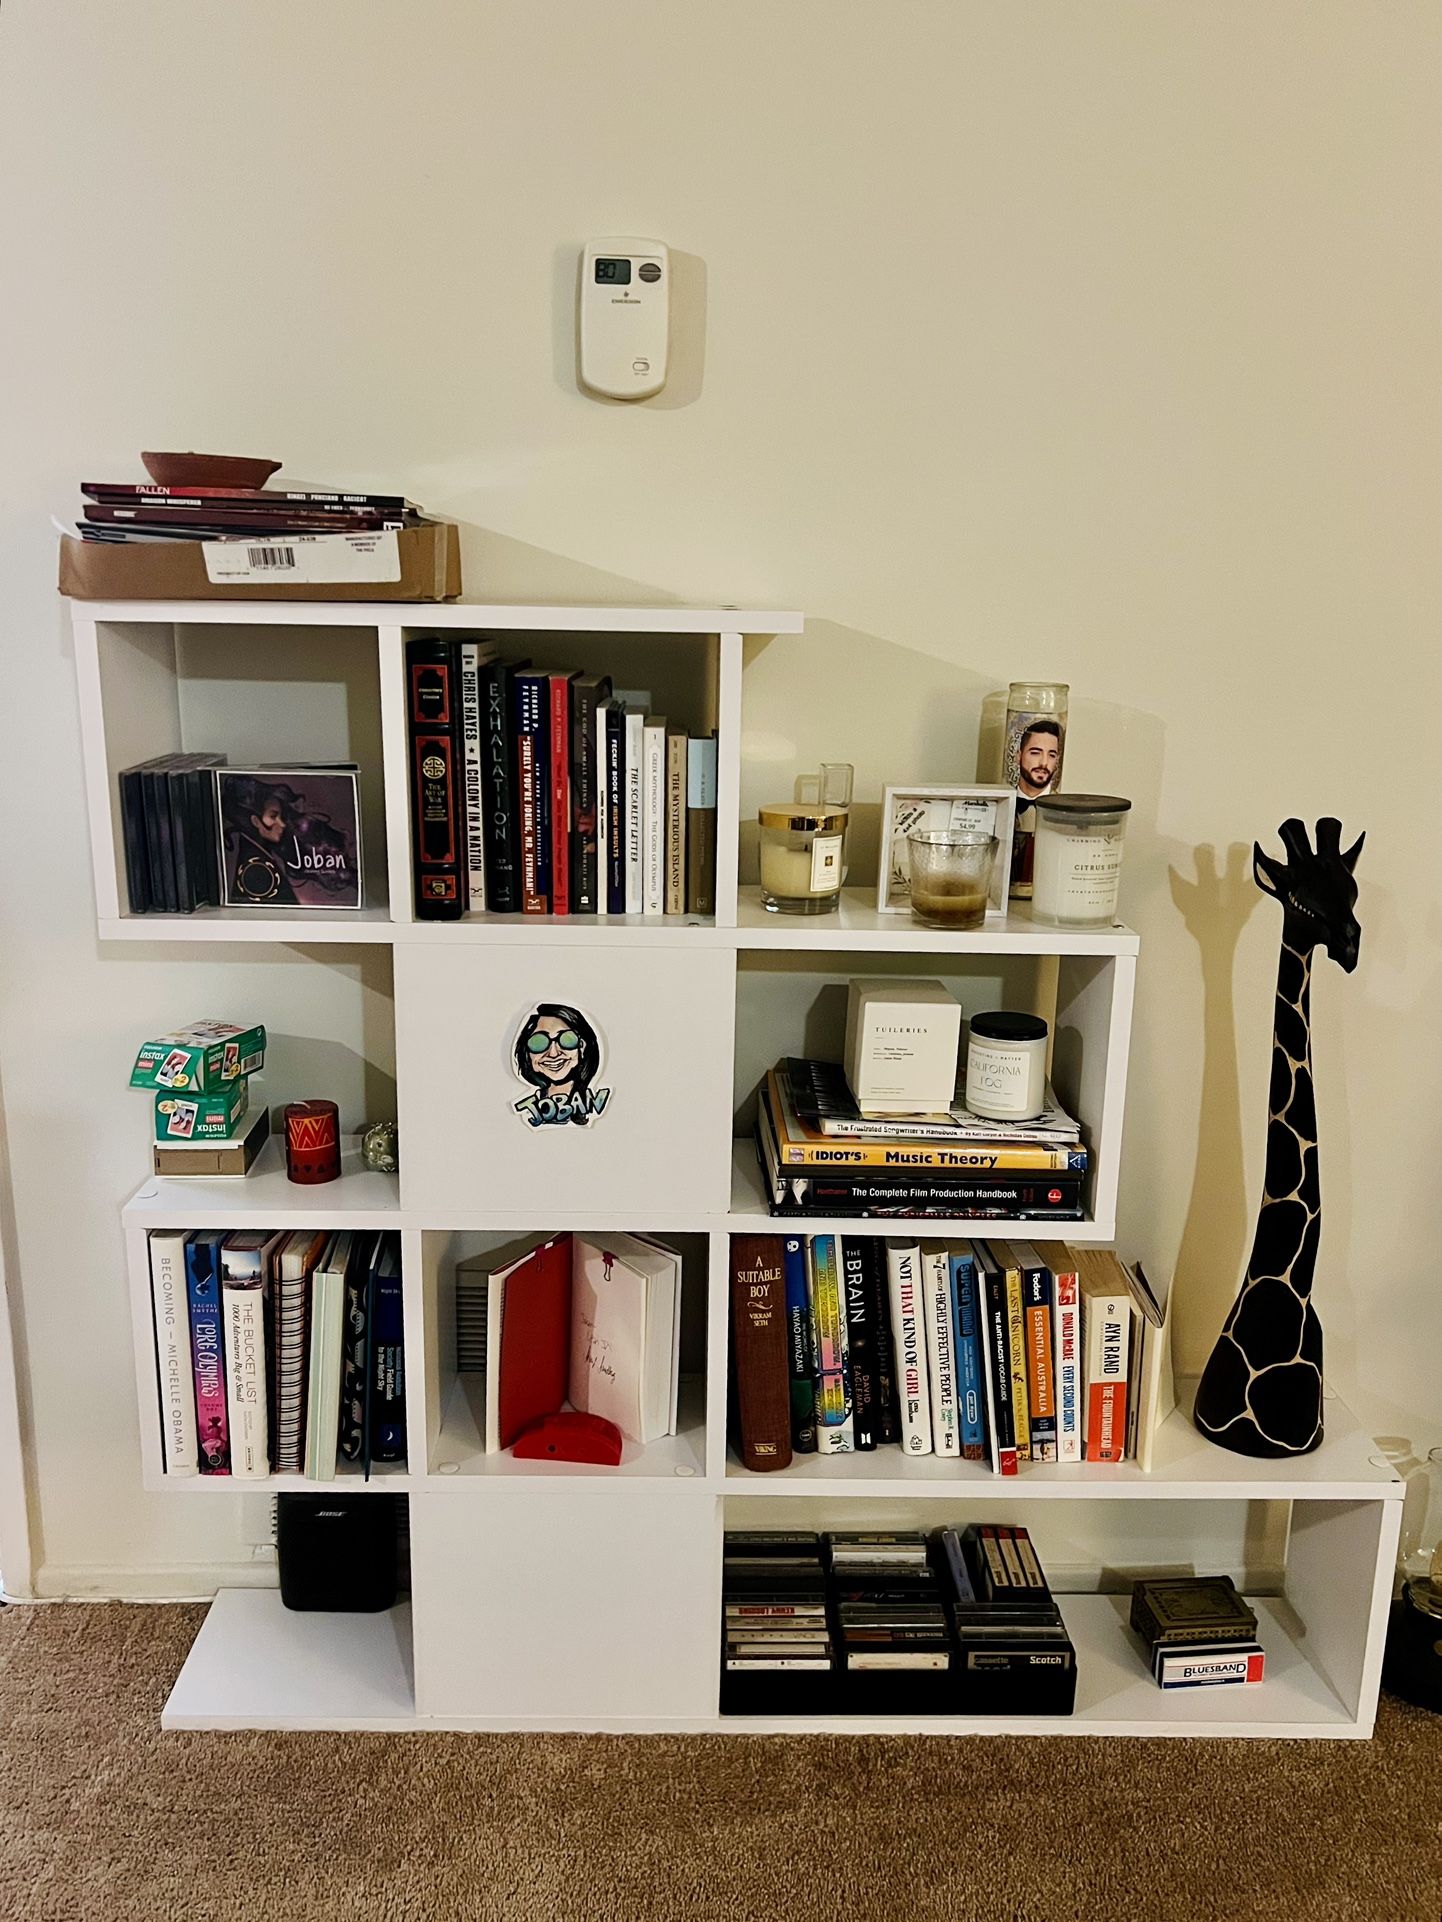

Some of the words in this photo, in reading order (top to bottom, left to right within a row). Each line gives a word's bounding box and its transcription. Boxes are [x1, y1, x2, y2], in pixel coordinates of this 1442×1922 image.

[597, 262, 616, 279] 80
[136, 485, 170, 496] FALLEN
[463, 671, 476, 704] CHRIS
[464, 707, 478, 741] HAYES
[466, 758, 479, 766] A
[489, 683, 507, 840] EXHALATION
[611, 739, 619, 769] FECKIN'
[466, 769, 480, 809] COLONY
[524, 772, 533, 802] YOU'RE
[630, 767, 639, 785] THE
[672, 772, 680, 791] THE
[612, 794, 619, 804] OF
[630, 788, 638, 827] SCARLET
[468, 812, 480, 822] IN
[524, 803, 533, 834] JOKING,
[672, 793, 680, 852] MYSTERIOUS
[287, 835, 346, 870] Joban
[469, 835, 482, 872] NATION
[524, 836, 534, 851] MR.
[612, 827, 620, 858] INSULTS
[630, 829, 639, 863] LETTER
[672, 854, 680, 888] ISLAND
[1074, 864, 1105, 872] CITRUS
[139, 1050, 166, 1061] instax
[196, 1124, 226, 1133] instax
[815, 1150, 862, 1162] IDIOT'S
[885, 1151, 932, 1164] Music
[937, 1152, 998, 1169] Theory
[852, 1187, 866, 1197] The
[868, 1187, 908, 1199] Complete
[909, 1188, 928, 1198] Film
[930, 1188, 975, 1199] Production
[976, 1189, 1018, 1199] Handbook
[737, 1267, 782, 1283] SUITABLE
[755, 1256, 764, 1268] A
[899, 1256, 913, 1281] NOT
[932, 1262, 946, 1270] 7
[161, 1257, 176, 1326] BECOMING
[750, 1284, 770, 1298] BOY
[846, 1259, 866, 1323] BRAIN
[959, 1263, 973, 1303] SUPER
[1032, 1272, 1042, 1301] Fodor's
[900, 1282, 914, 1316] THAT
[935, 1292, 947, 1324] HIGHLY
[1009, 1289, 1019, 1314] LAST
[232, 1303, 241, 1323] 1000
[243, 1302, 254, 1325] THE
[749, 1312, 772, 1320] VIKRAM
[791, 1306, 802, 1334] HAYAO
[1061, 1312, 1074, 1338] DONALD
[195, 1319, 219, 1350] LORE
[902, 1317, 917, 1349] KIND
[995, 1324, 1005, 1363] ANTI-RACIST
[1010, 1314, 1022, 1367] UNICORN
[1034, 1310, 1045, 1360] ESSENTIAL
[1104, 1322, 1121, 1343] AYN
[244, 1329, 256, 1377] BUCKET
[794, 1334, 804, 1372] MIYAZAKI
[904, 1351, 918, 1367] OF
[937, 1326, 951, 1372] EFFECTIVE
[1103, 1346, 1120, 1374] RAND
[167, 1344, 181, 1404] MICHELLE
[195, 1351, 219, 1398] OLYMPUS
[233, 1361, 243, 1374] Big
[376, 1364, 385, 1379] Night
[386, 1368, 394, 1383] Field
[998, 1363, 1006, 1384] VOCAB
[1062, 1365, 1075, 1384] EVERY
[235, 1382, 245, 1403] Small
[245, 1381, 258, 1405] LIST
[376, 1379, 385, 1391] Sky
[853, 1365, 863, 1414] EAGLEMAN
[862, 1375, 871, 1404] DAVID
[905, 1368, 919, 1398] GIRL
[940, 1373, 952, 1406] PEOPLE
[1000, 1384, 1008, 1401] GUIDE
[1036, 1361, 1047, 1413] AUSTRALIA
[1062, 1384, 1075, 1408] SECOND
[1102, 1384, 1114, 1399] THE
[172, 1409, 184, 1454] OBAMA
[1062, 1409, 1075, 1433] COUNTS
[1100, 1399, 1114, 1449] FOUNTAINHEAD
[1029, 1655, 1062, 1664] Scotch
[1183, 1663, 1247, 1678] BLUESBAND
